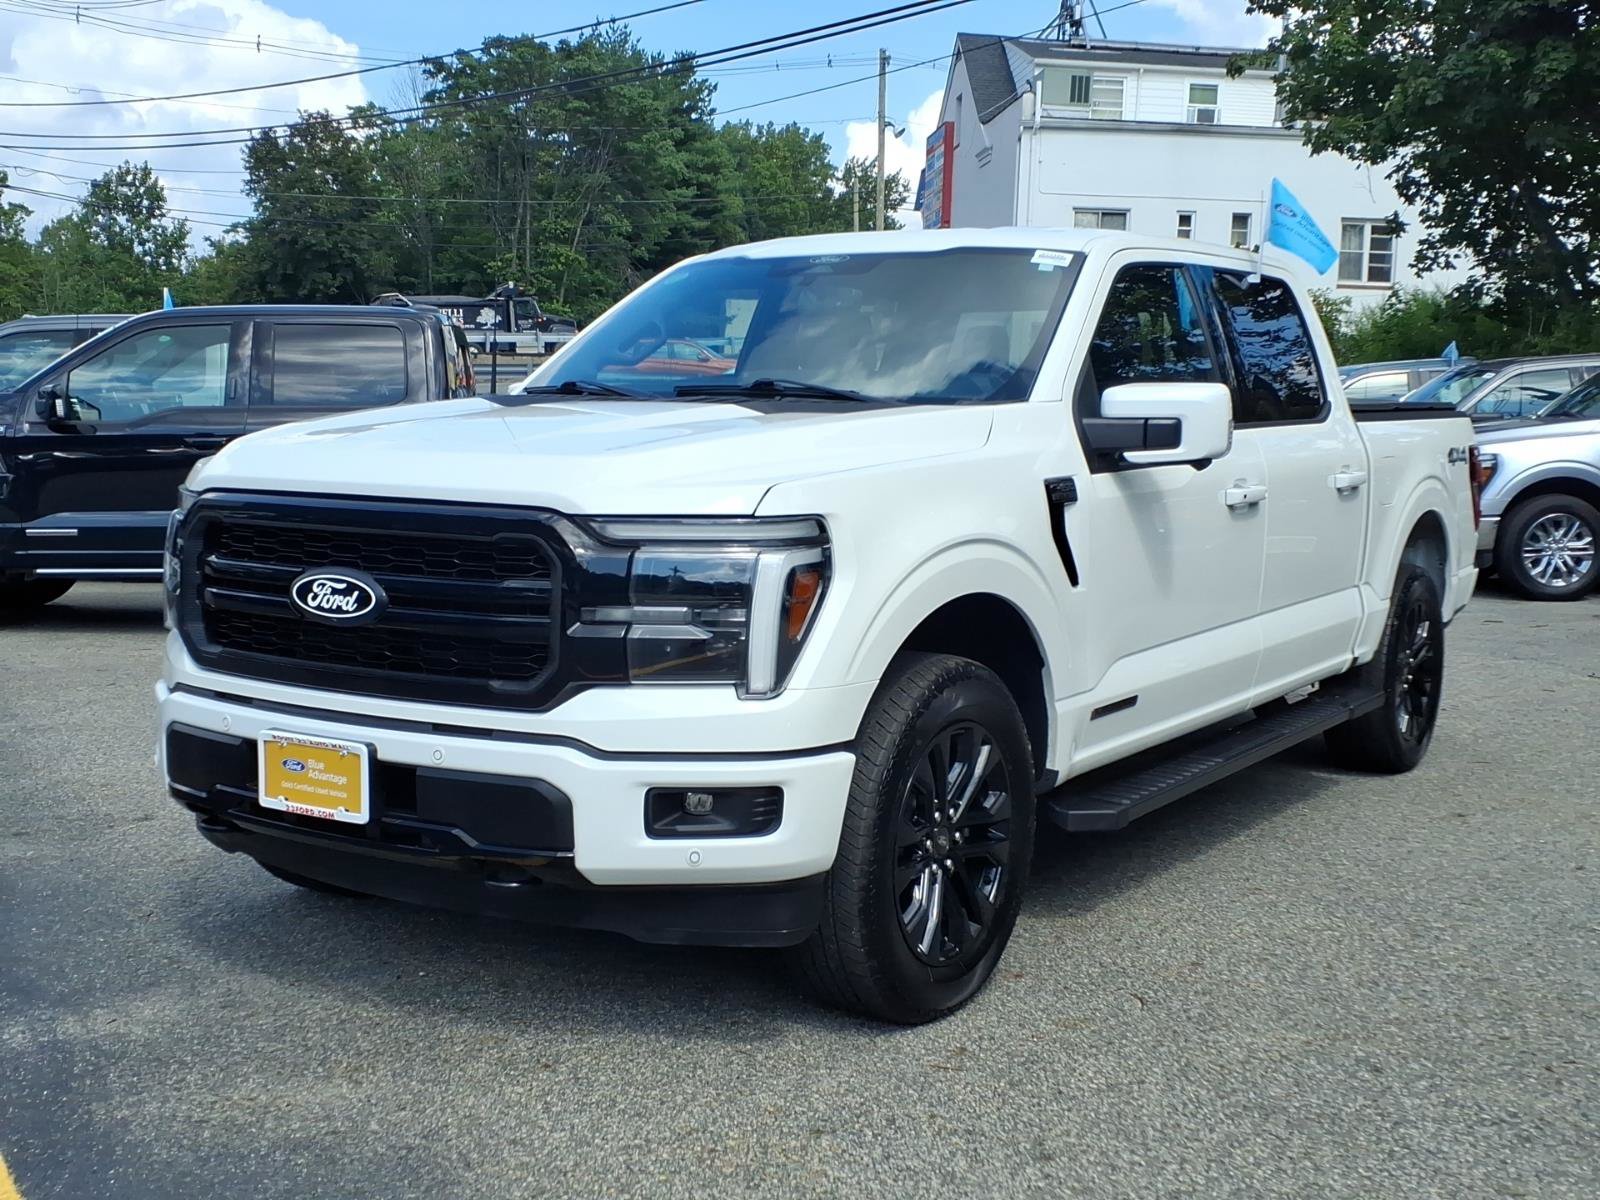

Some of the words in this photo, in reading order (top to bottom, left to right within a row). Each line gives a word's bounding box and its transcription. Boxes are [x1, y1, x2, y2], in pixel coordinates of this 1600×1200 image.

[306, 579, 360, 612] Ford
[308, 759, 325, 770] Blue
[308, 769, 348, 785] Advantage
